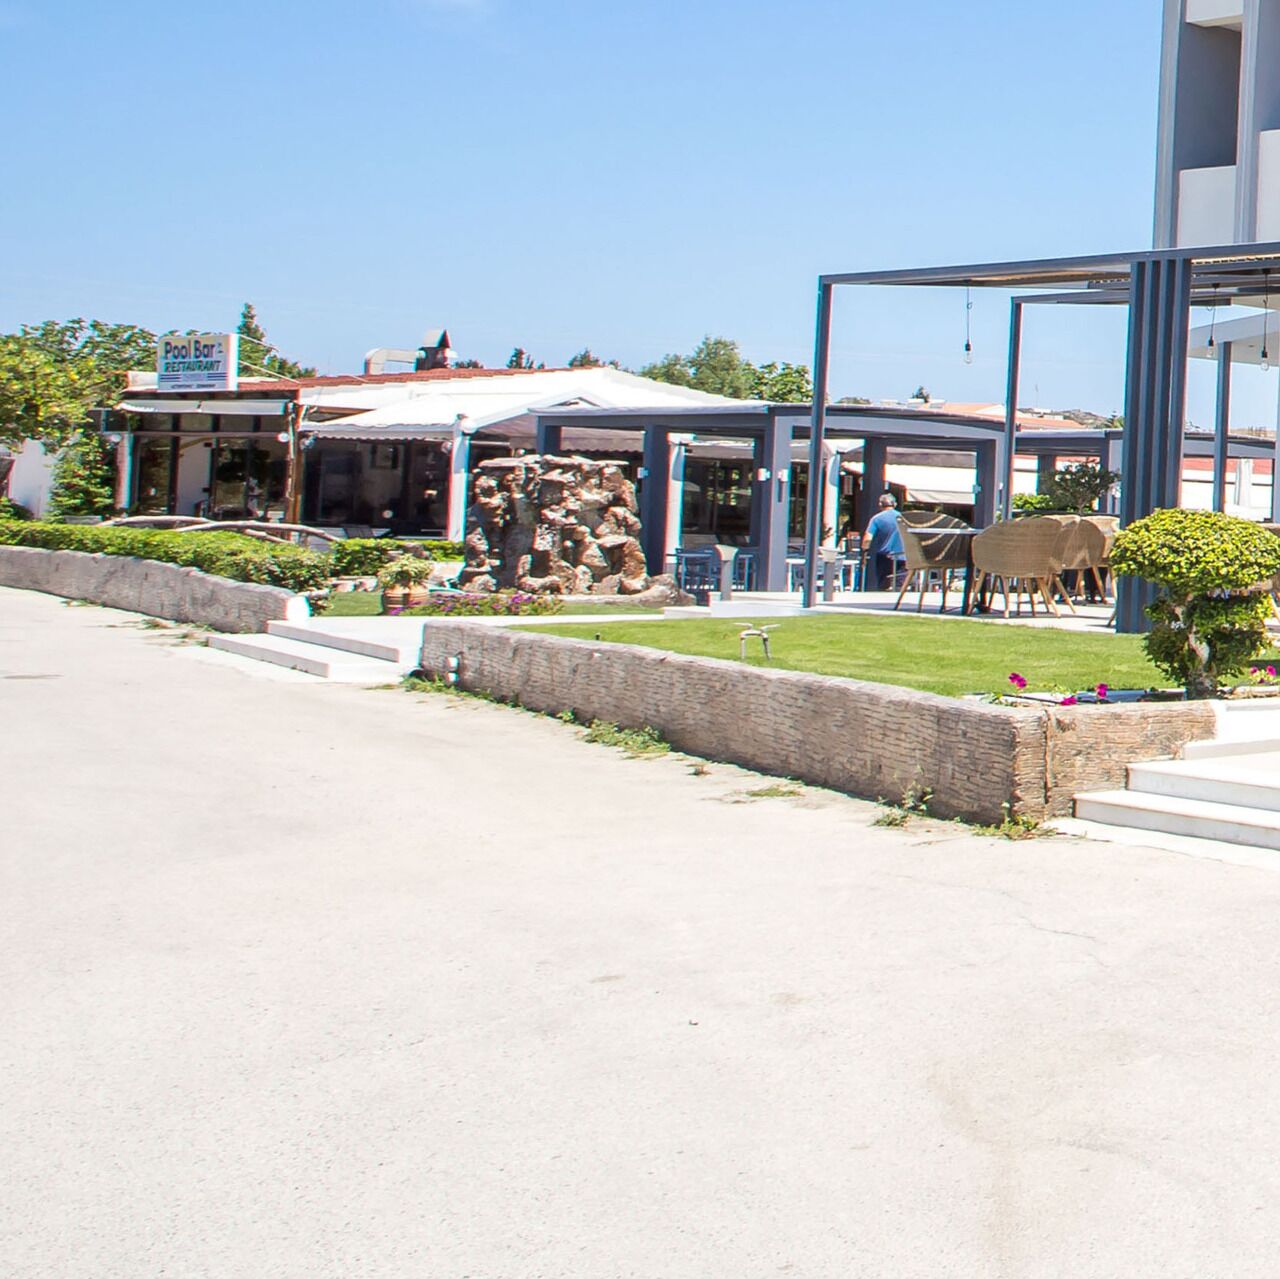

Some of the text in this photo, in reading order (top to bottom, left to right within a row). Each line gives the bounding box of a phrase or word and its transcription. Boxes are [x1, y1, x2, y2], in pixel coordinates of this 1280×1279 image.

[164, 339, 216, 360] Pool Bar
[164, 360, 221, 373] RESTAURANT
